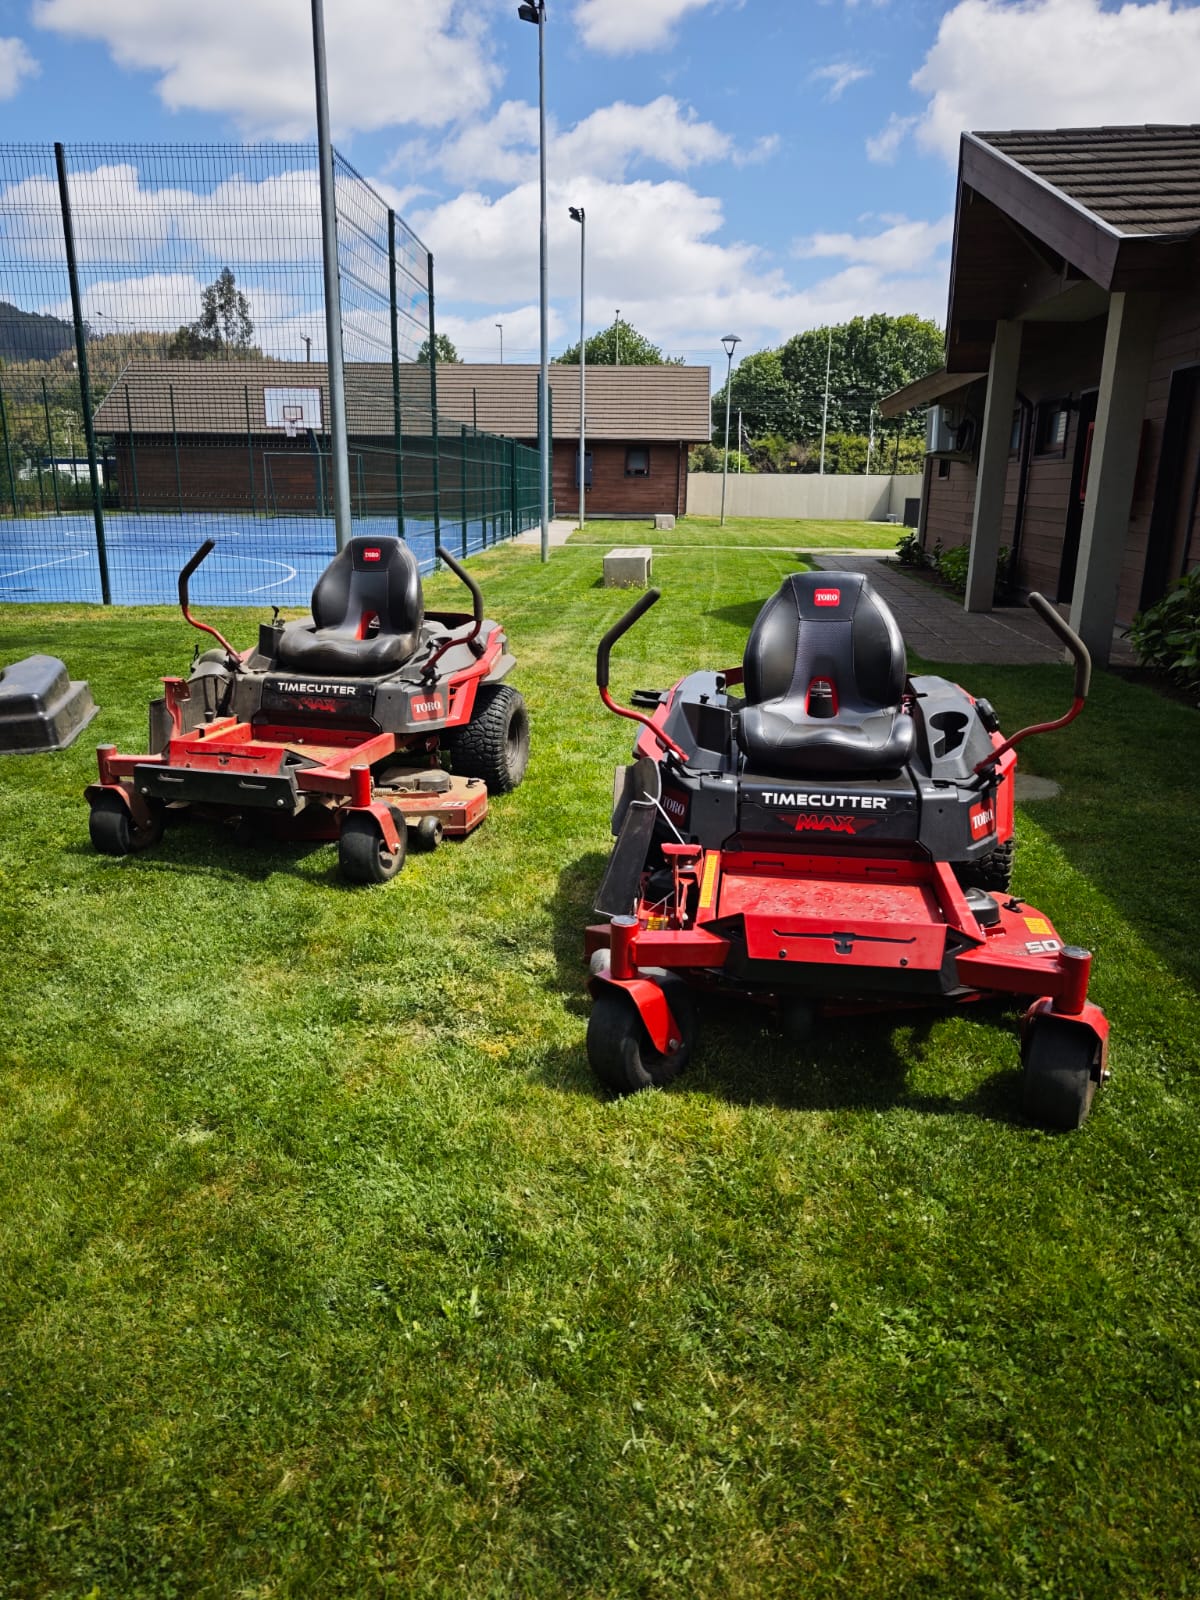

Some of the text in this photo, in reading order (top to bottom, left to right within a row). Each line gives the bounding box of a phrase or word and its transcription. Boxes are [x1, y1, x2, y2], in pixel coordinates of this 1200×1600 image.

[816, 593, 838, 601] TORO
[277, 682, 356, 695] TIMECUTTER
[414, 701, 441, 713] TORO
[662, 795, 685, 816] TORO
[761, 792, 887, 809] TIMECUTTER
[795, 813, 856, 834] MAX
[972, 809, 993, 829] TORO
[1025, 939, 1061, 954] 50
